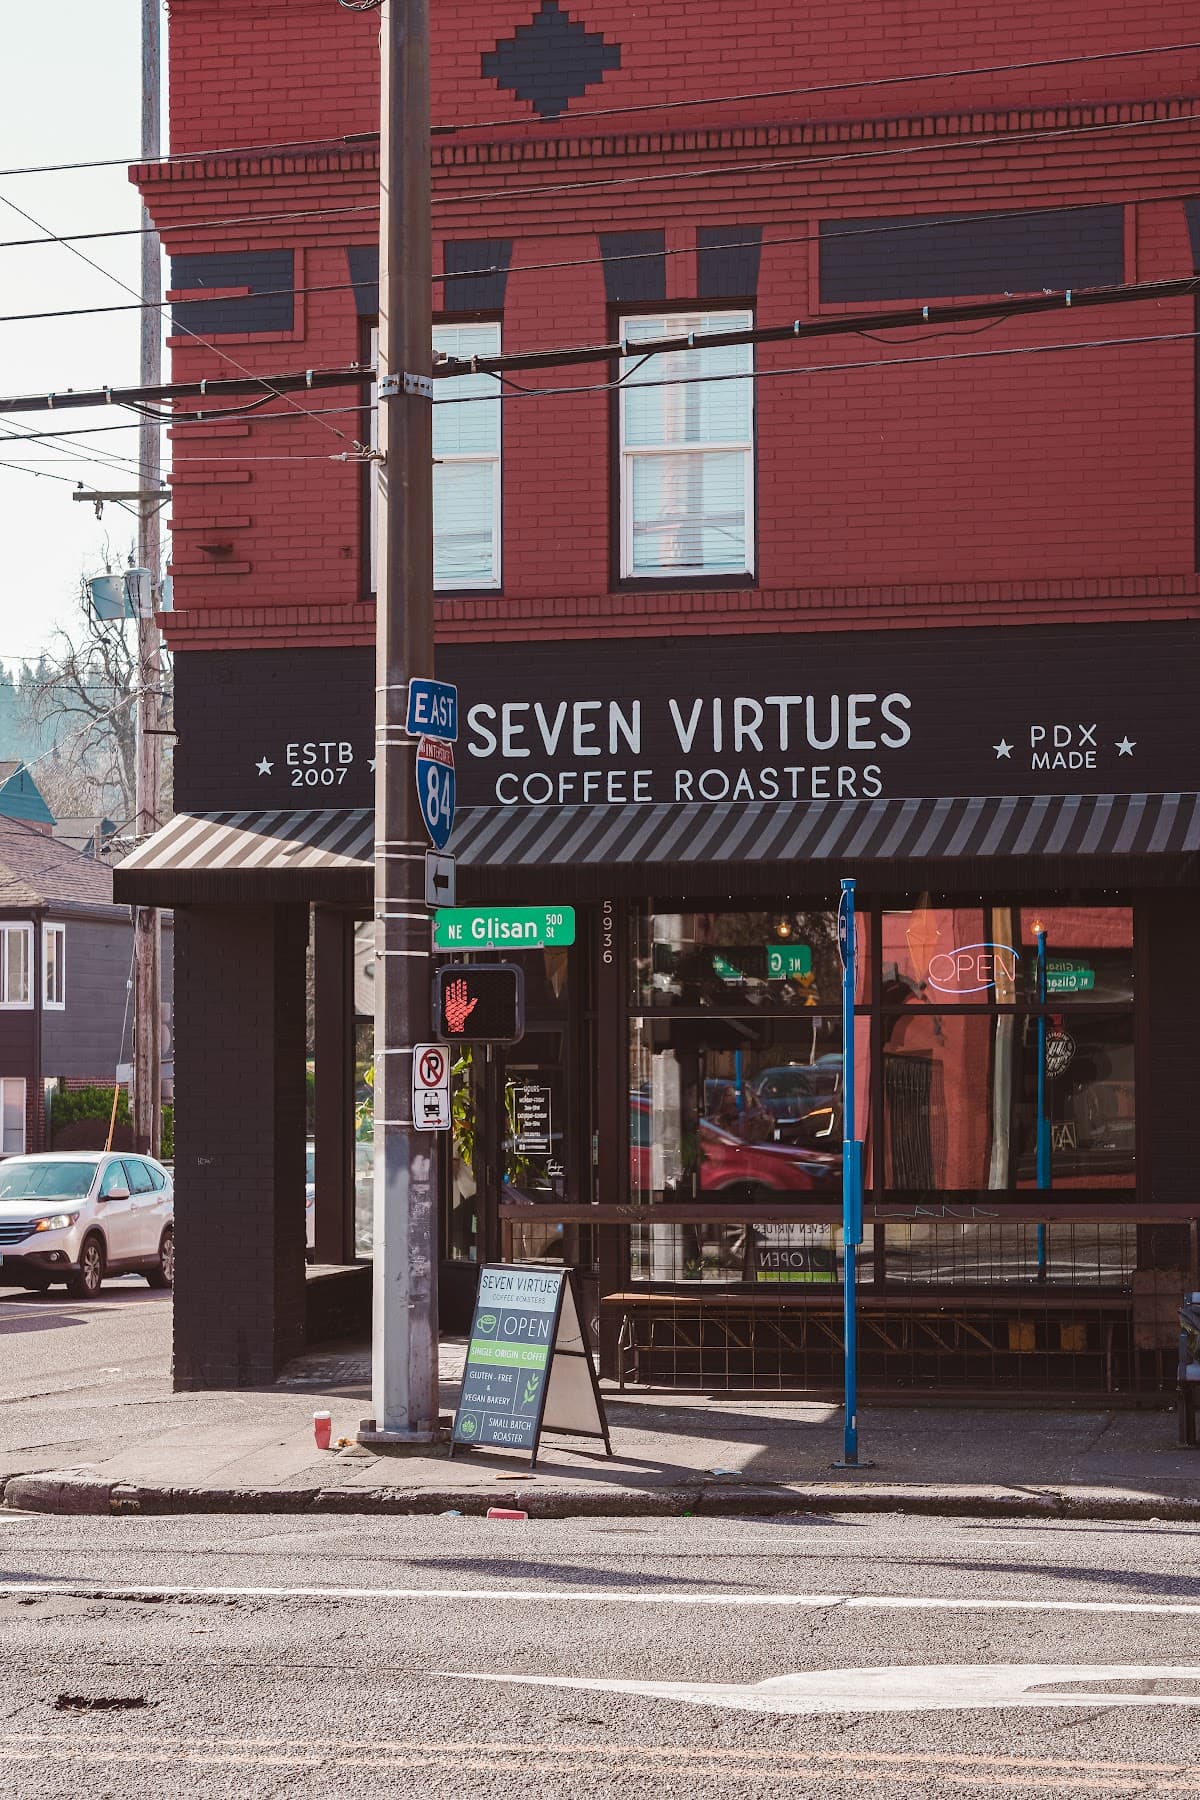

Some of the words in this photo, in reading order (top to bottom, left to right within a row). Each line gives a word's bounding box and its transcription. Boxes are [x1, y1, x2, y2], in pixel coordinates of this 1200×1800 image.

[415, 692, 454, 728] EAST
[467, 700, 641, 758] SEVEN
[668, 692, 912, 754] VIRTUES
[1030, 723, 1098, 748] PDX
[286, 742, 354, 766] ESTB
[1031, 751, 1097, 770] MADE
[291, 768, 348, 787] 2007
[495, 769, 653, 804] COFFEE
[674, 764, 883, 801] ROASTERS
[426, 765, 451, 830] 84
[448, 925, 463, 940] NE
[471, 917, 538, 940] Glisan
[546, 927, 555, 938] St
[545, 913, 563, 926] 500
[928, 953, 1016, 982] OPEN
[482, 1275, 514, 1291] SEVEN
[517, 1277, 559, 1294] VIRTUES
[503, 1316, 550, 1338] OPEN
[471, 1346, 492, 1357] SINGLE
[494, 1348, 519, 1359] ORIGIN
[465, 1393, 486, 1403] VEGAN
[486, 1395, 511, 1405] BAKERY
[488, 1417, 509, 1429] SMALL
[509, 1419, 532, 1431] BATCH
[492, 1431, 523, 1443] ROASTER
